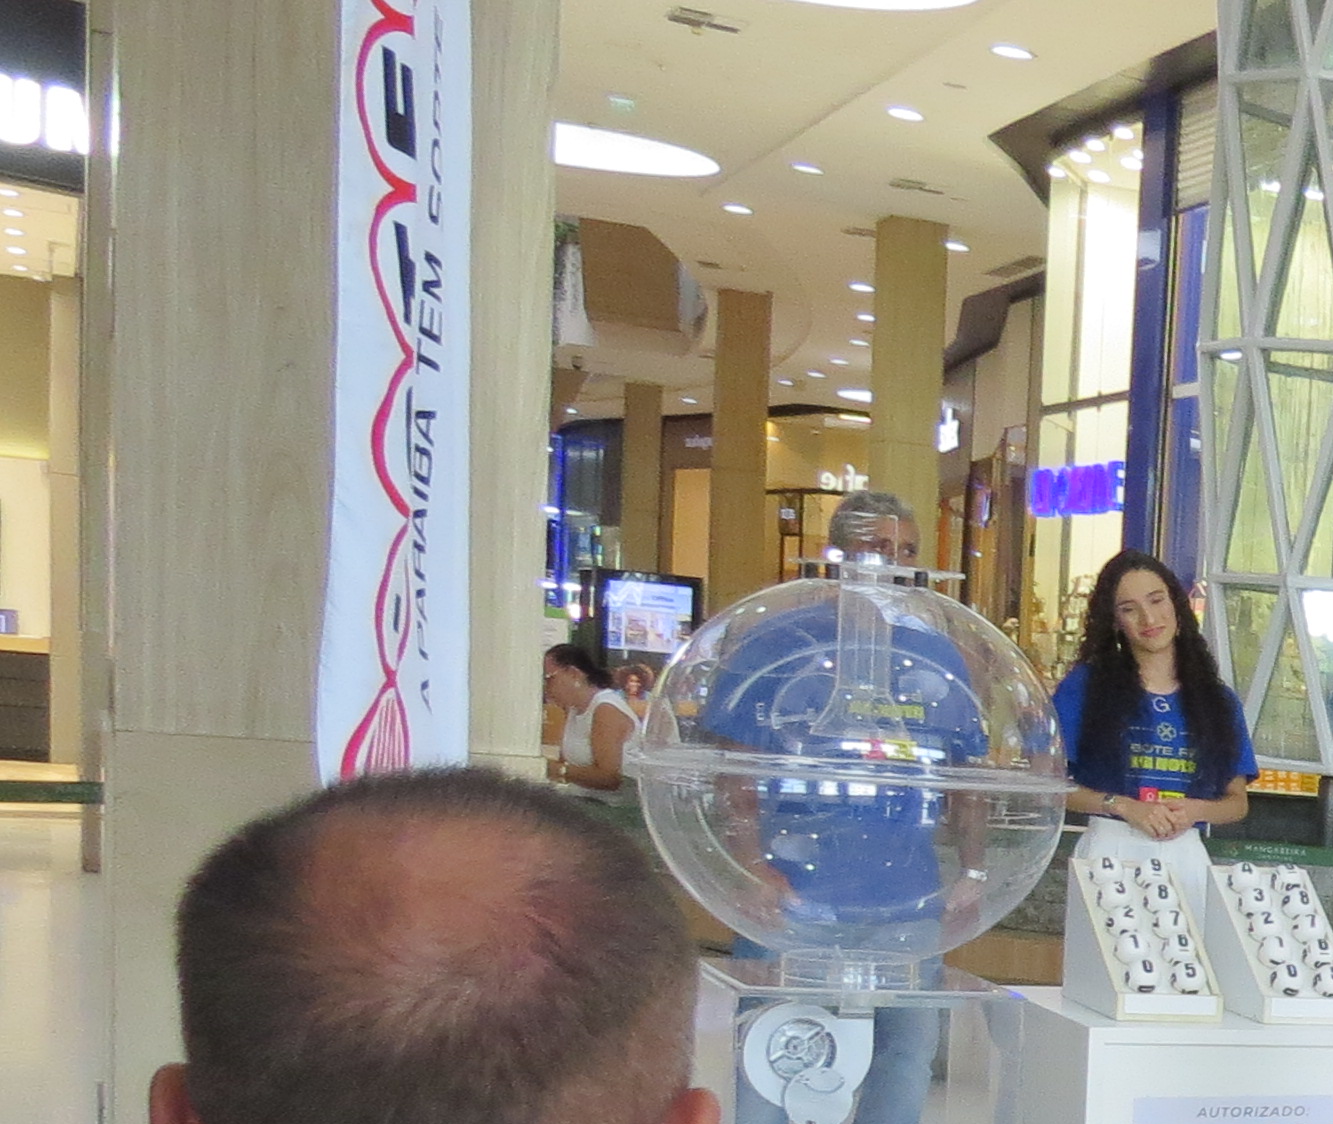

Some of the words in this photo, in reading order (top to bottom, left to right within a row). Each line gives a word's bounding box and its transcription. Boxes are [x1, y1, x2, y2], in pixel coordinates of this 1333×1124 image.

[414, 250, 443, 374] TEM
[1244, 844, 1307, 857] MANGABEIRA
[1102, 857, 1114, 870] 4
[1151, 858, 1162, 872] 9
[1241, 862, 1254, 875] 4
[1114, 881, 1126, 894] 3
[1158, 884, 1169, 900] 8
[1253, 888, 1265, 902] 3
[1299, 890, 1310, 905] 8
[1123, 905, 1135, 919] 2
[1169, 910, 1180, 926] 7
[1261, 911, 1274, 925] 2
[1305, 913, 1316, 928] 7
[1129, 934, 1140, 949] 1
[1177, 933, 1189, 947] 6
[1317, 938, 1329, 951] 6
[1141, 959, 1154, 974] 0
[1184, 962, 1197, 978] 5
[1286, 964, 1298, 978] 0
[1195, 1106, 1311, 1119] AUTORIZADO:
